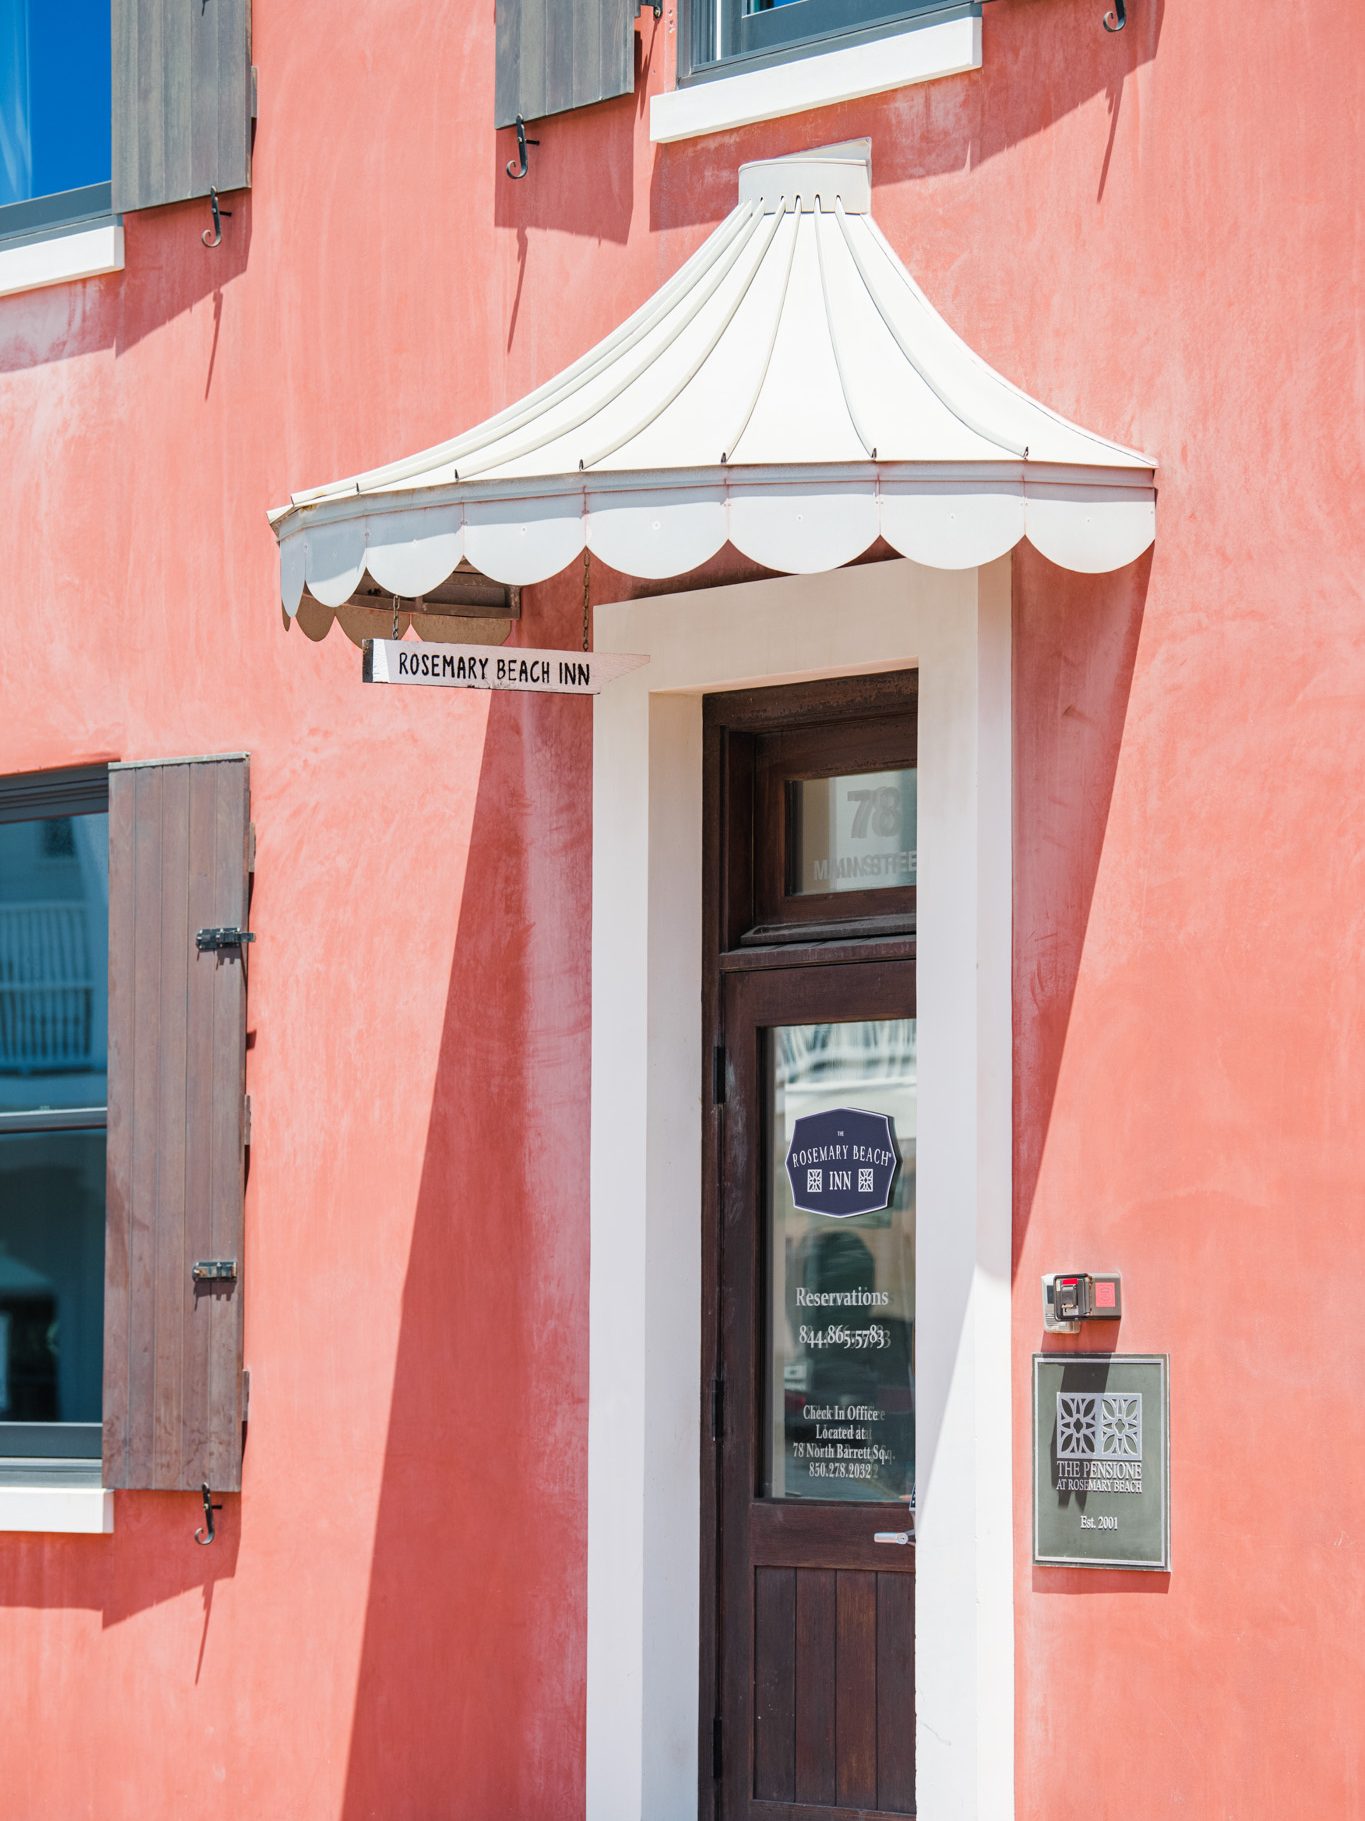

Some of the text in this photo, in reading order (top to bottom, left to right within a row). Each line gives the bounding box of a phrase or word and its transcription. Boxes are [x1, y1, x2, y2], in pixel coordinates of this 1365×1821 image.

[399, 652, 590, 686] ROSEMARY BEACH INN
[847, 786, 900, 839] 78
[792, 1145, 849, 1168] ROSEMARY
[829, 1171, 852, 1191] INN
[796, 1286, 889, 1307] Reservations
[799, 1324, 885, 1349] 844.865.5783
[803, 1405, 879, 1421] Check In Office
[816, 1424, 866, 1440] Located at
[793, 1442, 888, 1465] 78 North Barrett Sq.
[809, 1462, 872, 1479] 850.278.2032
[1057, 1461, 1142, 1479] THE PENSIONE
[1056, 1478, 1142, 1493] AT ROSEMARY BEACH
[1080, 1515, 1118, 1530] Est. 2001
